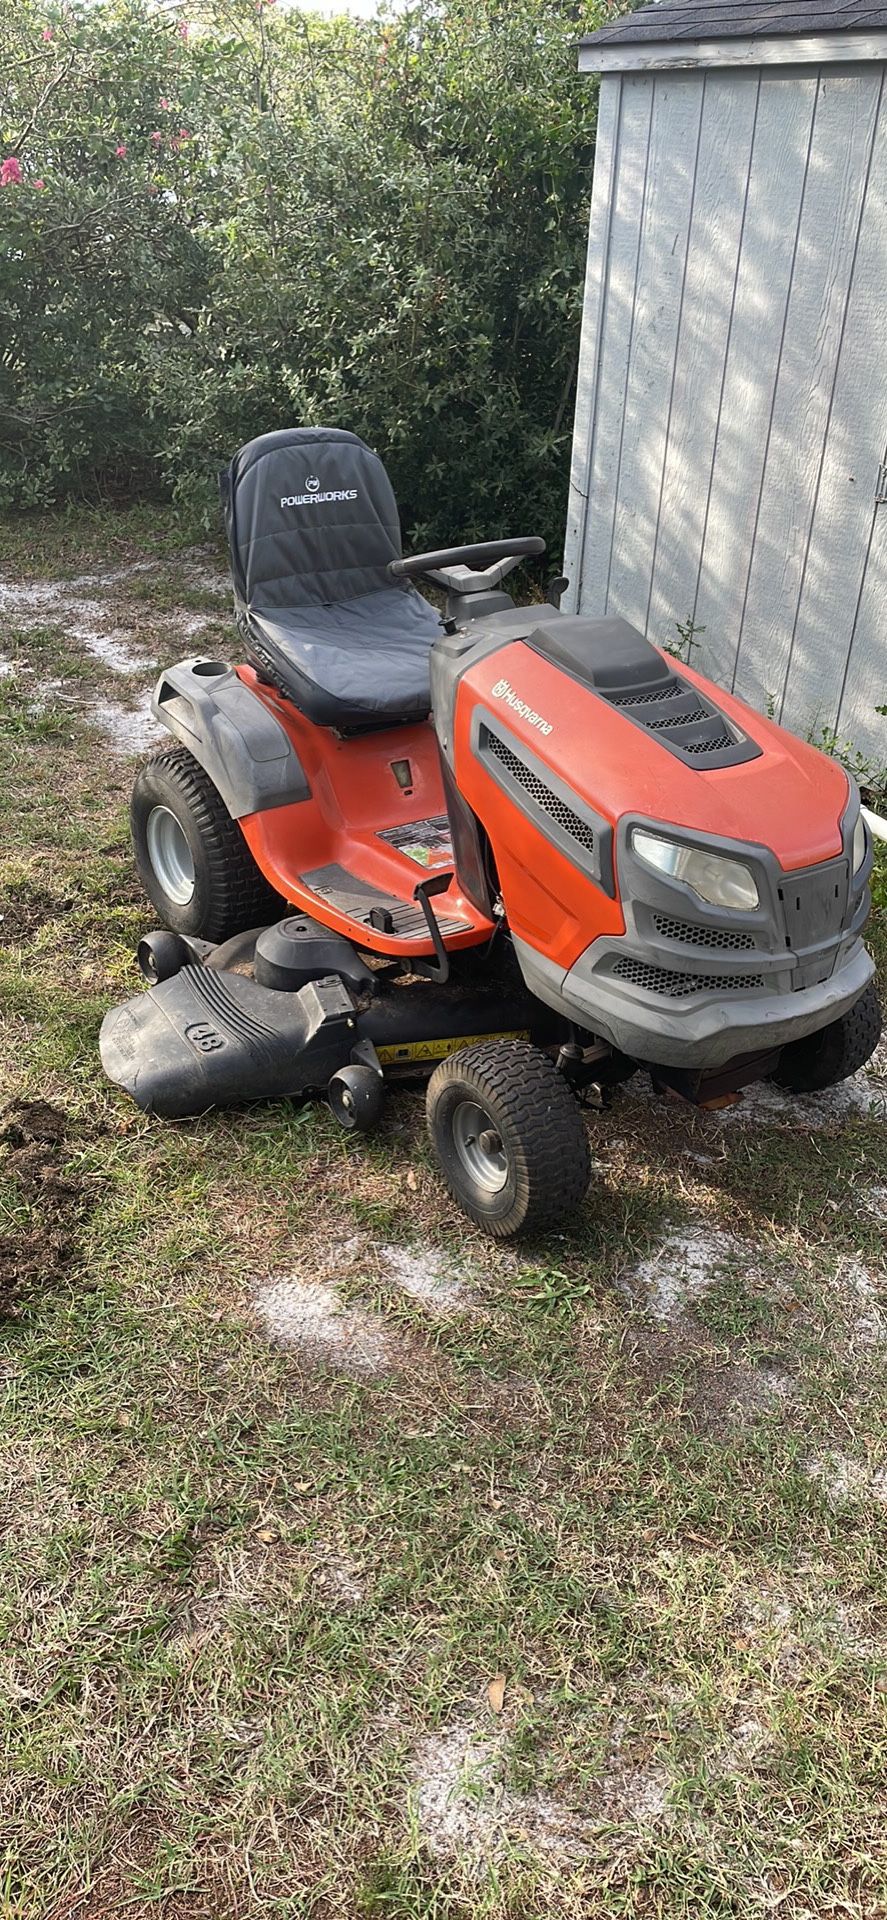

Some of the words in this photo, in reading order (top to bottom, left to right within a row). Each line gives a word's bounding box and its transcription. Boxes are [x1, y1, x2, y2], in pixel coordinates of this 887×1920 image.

[280, 489, 358, 508] POWERWORKS
[501, 687, 554, 736] Husqvarna
[189, 1026, 225, 1053] 48
